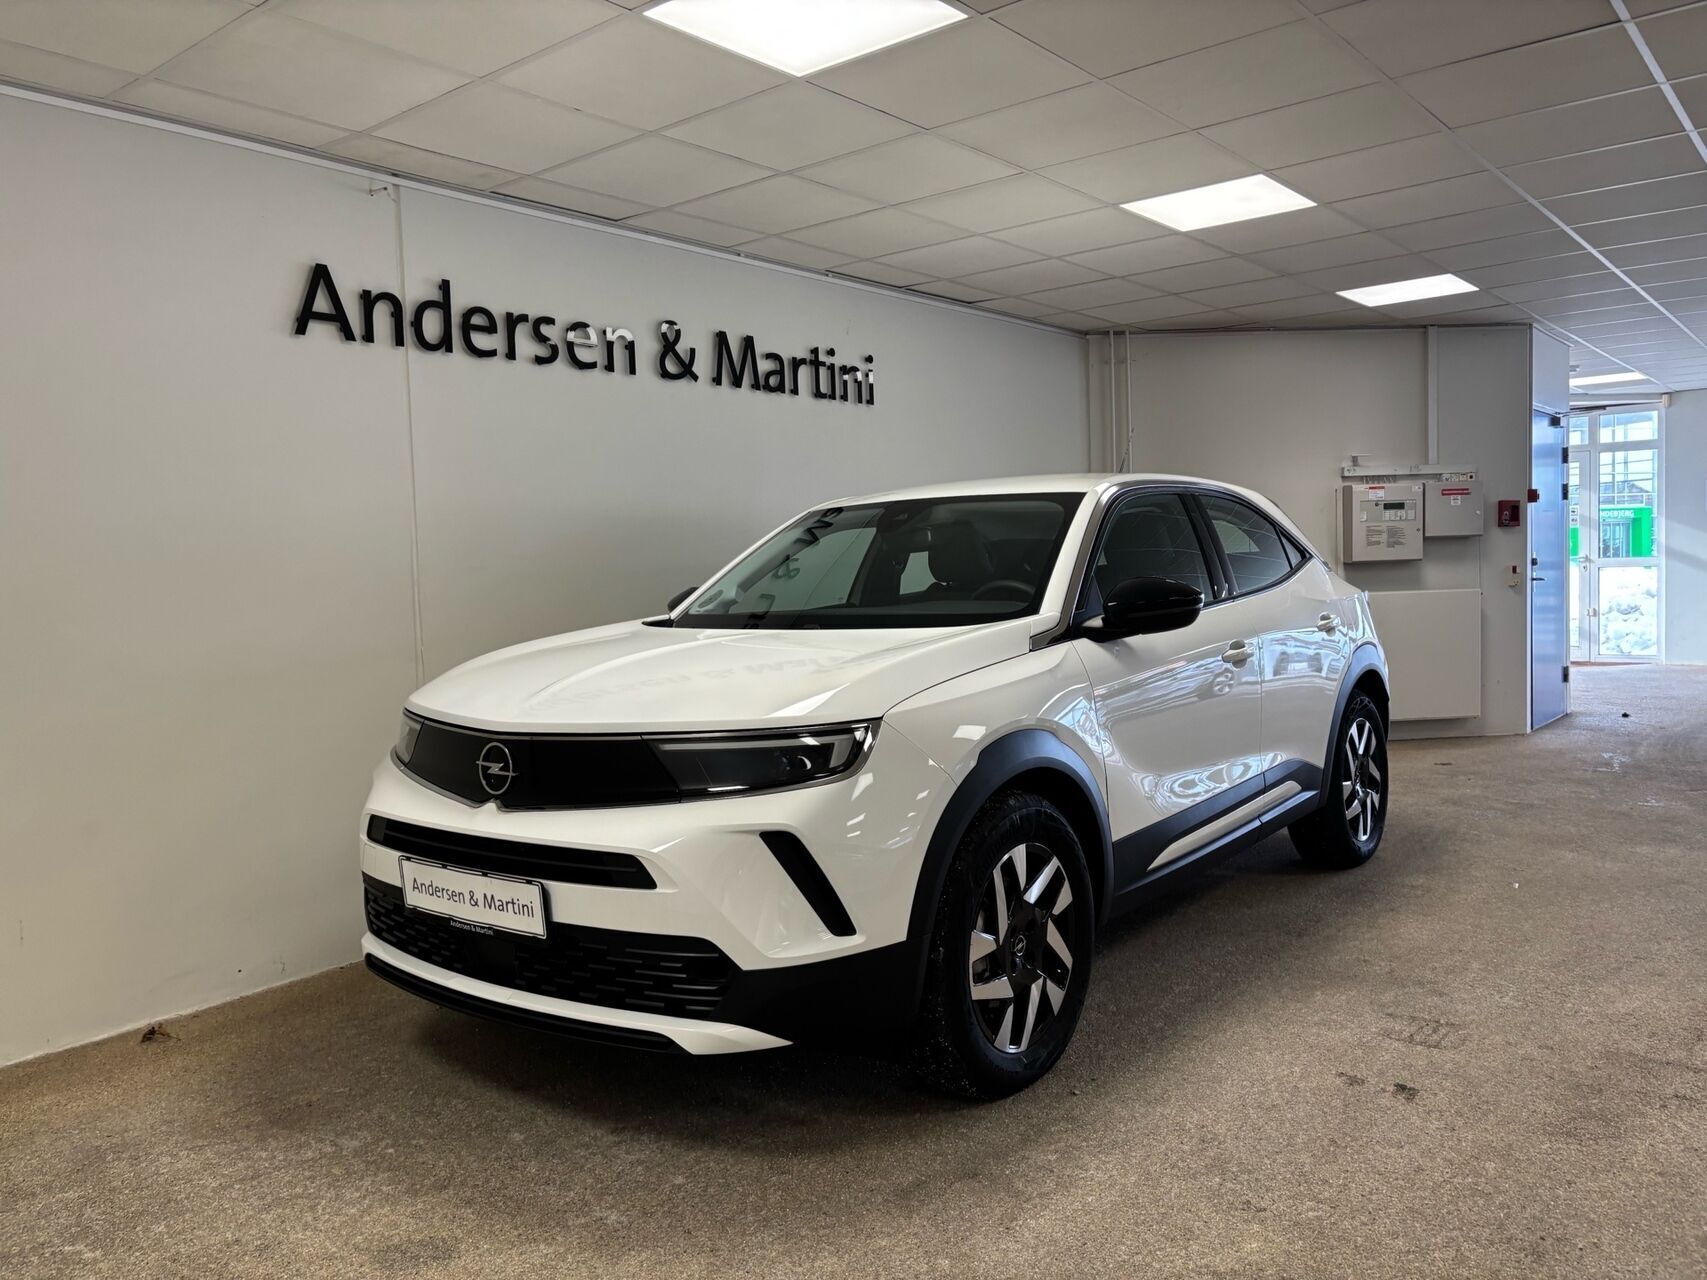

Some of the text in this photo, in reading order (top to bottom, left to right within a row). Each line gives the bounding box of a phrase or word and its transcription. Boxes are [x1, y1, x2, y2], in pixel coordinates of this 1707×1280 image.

[295, 262, 875, 406] Andersen & Martini
[412, 877, 535, 918] Andersen & Martini
[450, 919, 471, 931] Andersen
[476, 925, 494, 936] Martini
